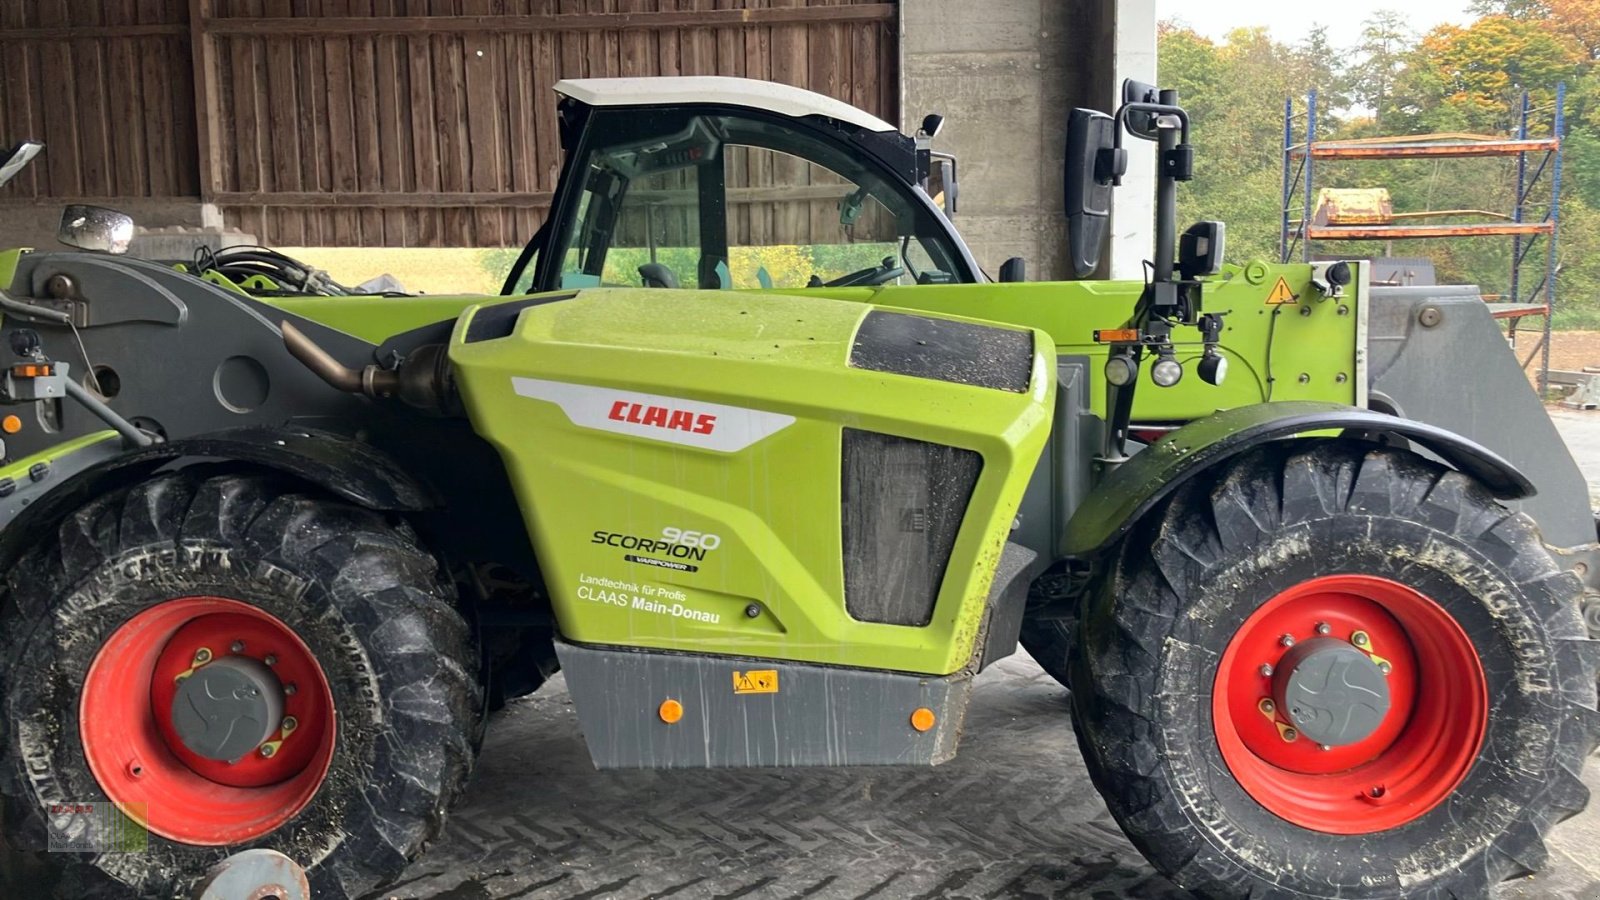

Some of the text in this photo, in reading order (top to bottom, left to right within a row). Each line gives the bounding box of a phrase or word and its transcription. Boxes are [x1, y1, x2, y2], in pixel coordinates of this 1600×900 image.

[608, 401, 717, 435] CLAAS
[591, 531, 706, 561] SCORPION
[660, 526, 721, 551] 960
[636, 556, 688, 571] VARIPOWER
[579, 573, 687, 602] Landtechnik für Profis
[577, 585, 720, 624] CLAAS Main-Donau
